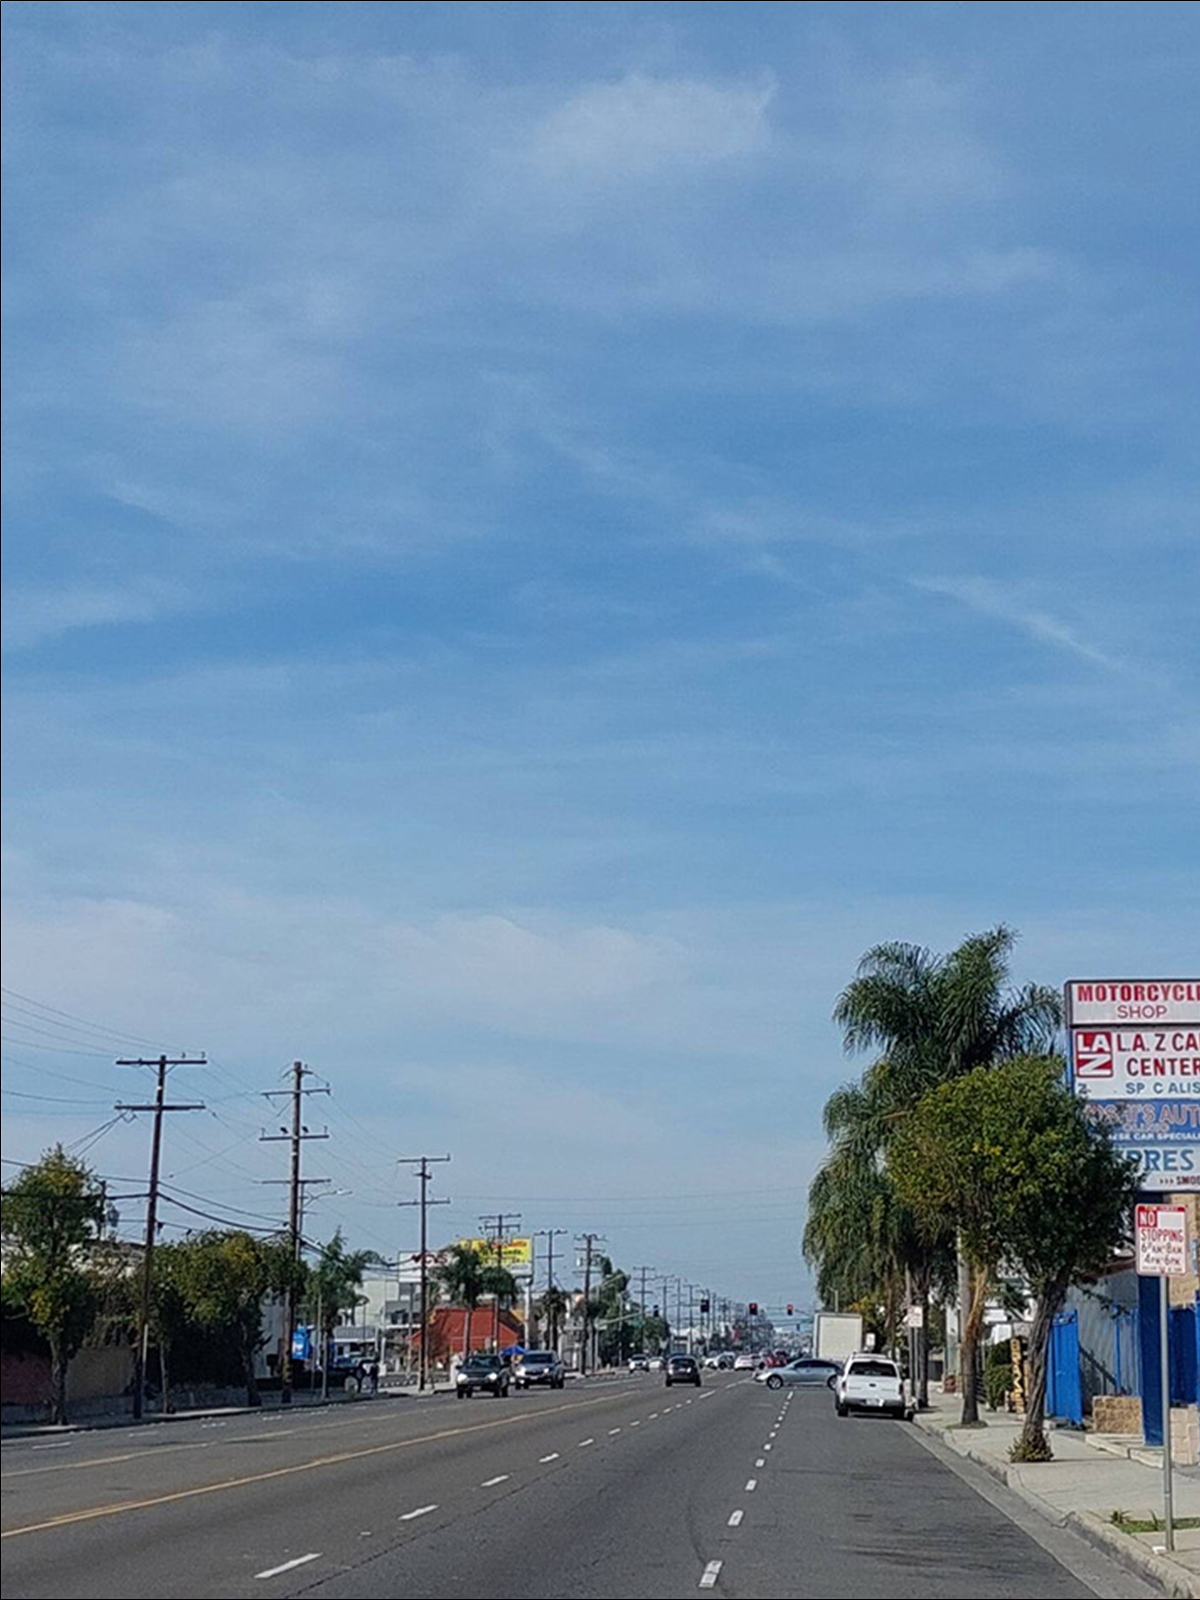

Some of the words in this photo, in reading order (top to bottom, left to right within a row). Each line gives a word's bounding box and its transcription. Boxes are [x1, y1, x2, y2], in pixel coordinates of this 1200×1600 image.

[1117, 1005, 1168, 1019] SHOP
[1154, 1033, 1166, 1051] Z
[1140, 1211, 1156, 1227] NO
[1141, 1228, 1184, 1242] STOPPING
